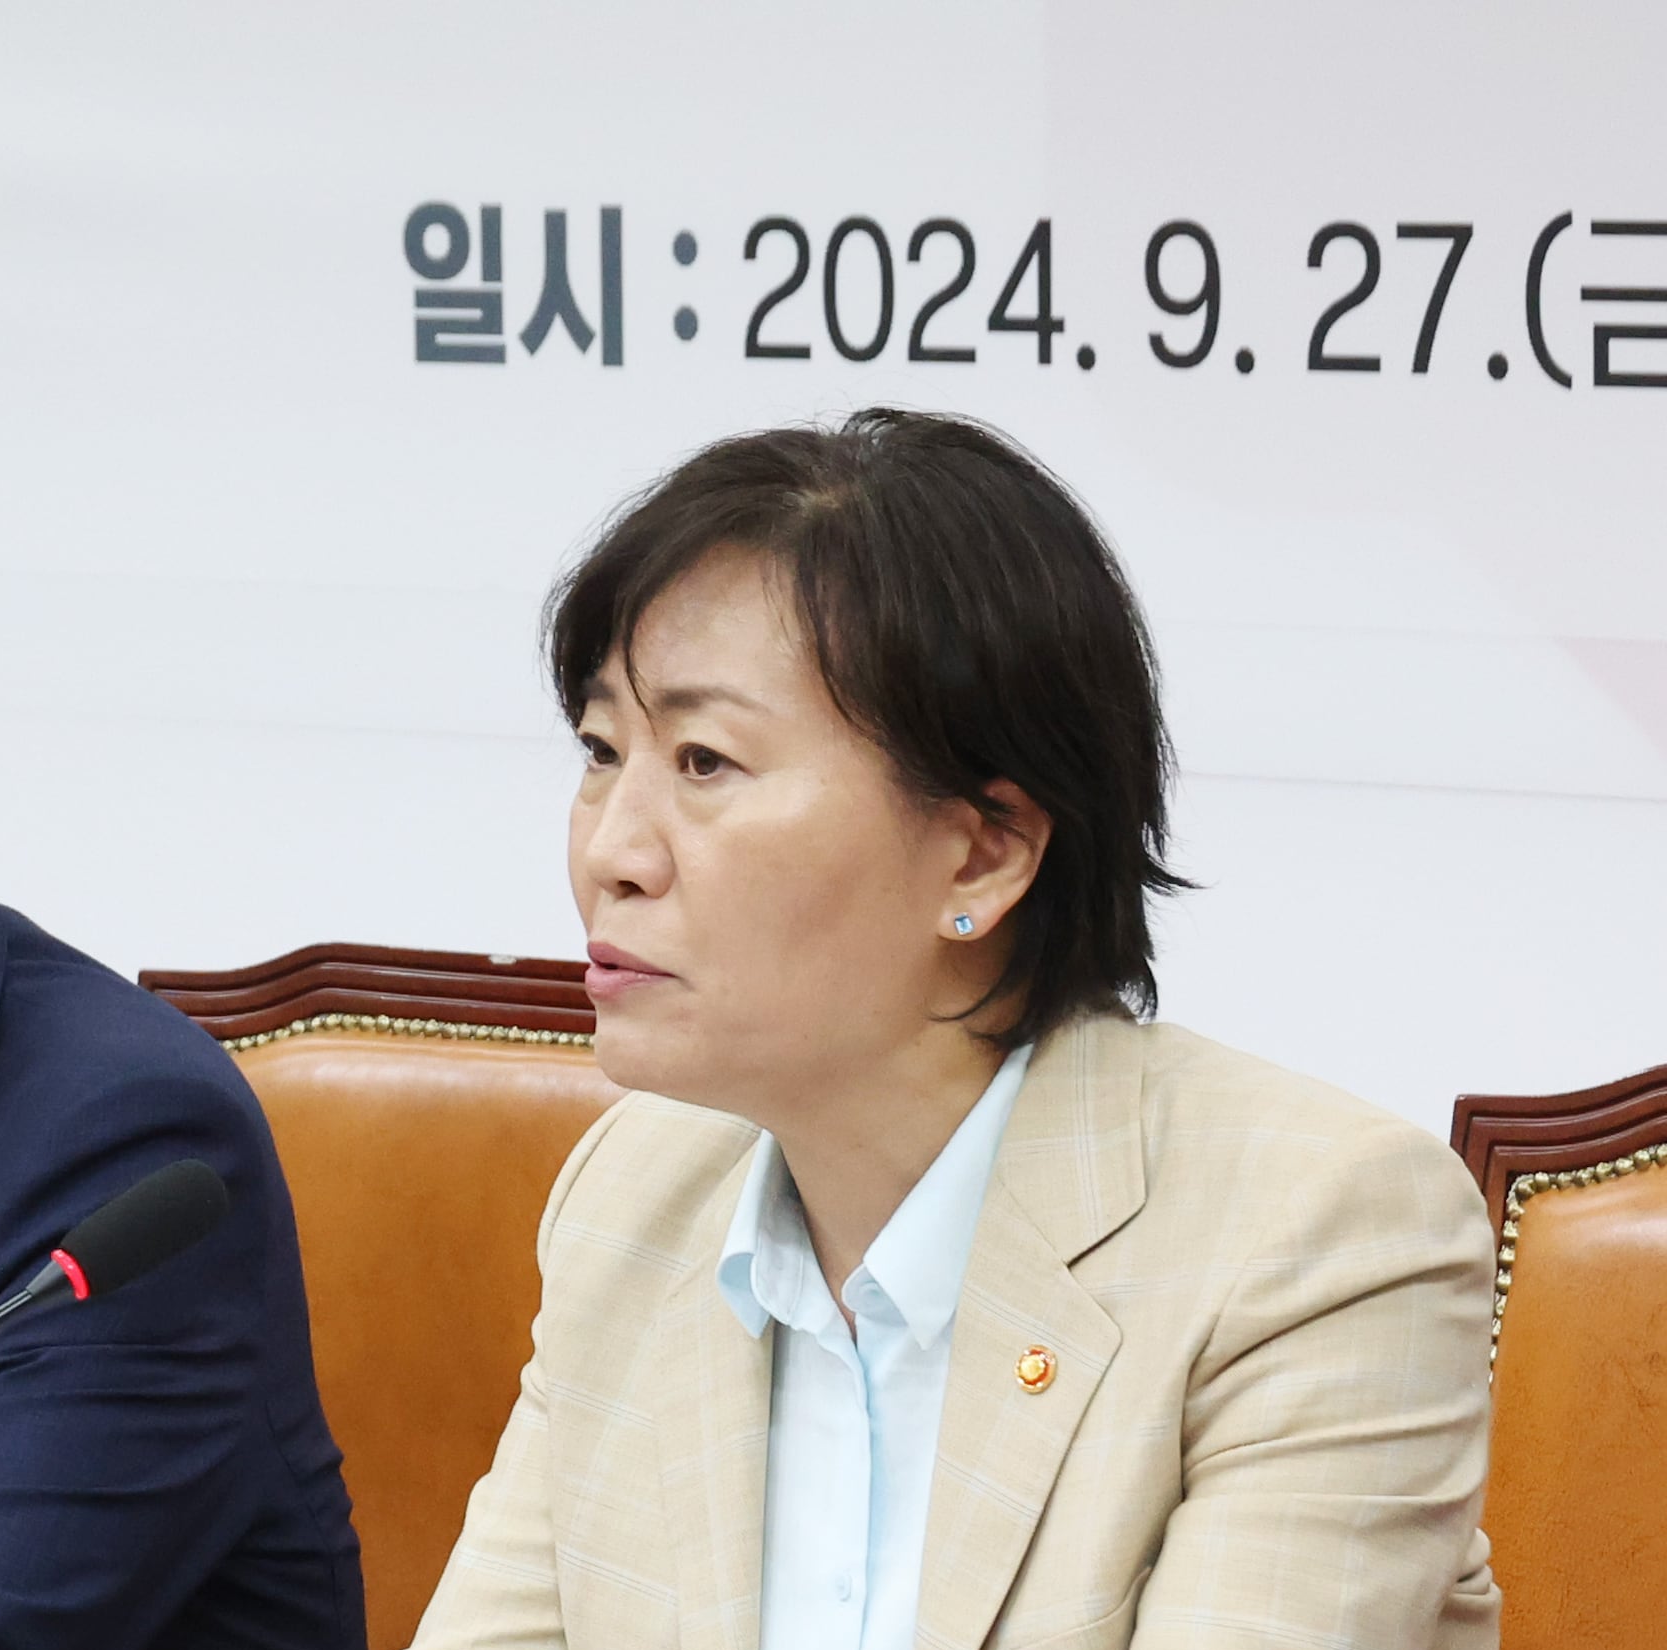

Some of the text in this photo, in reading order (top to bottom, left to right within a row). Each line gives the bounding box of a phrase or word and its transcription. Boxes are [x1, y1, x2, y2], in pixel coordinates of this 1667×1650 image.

[402, 200, 625, 368] 일시
[742, 214, 1097, 372] 2024.
[1143, 218, 1256, 376] 9.
